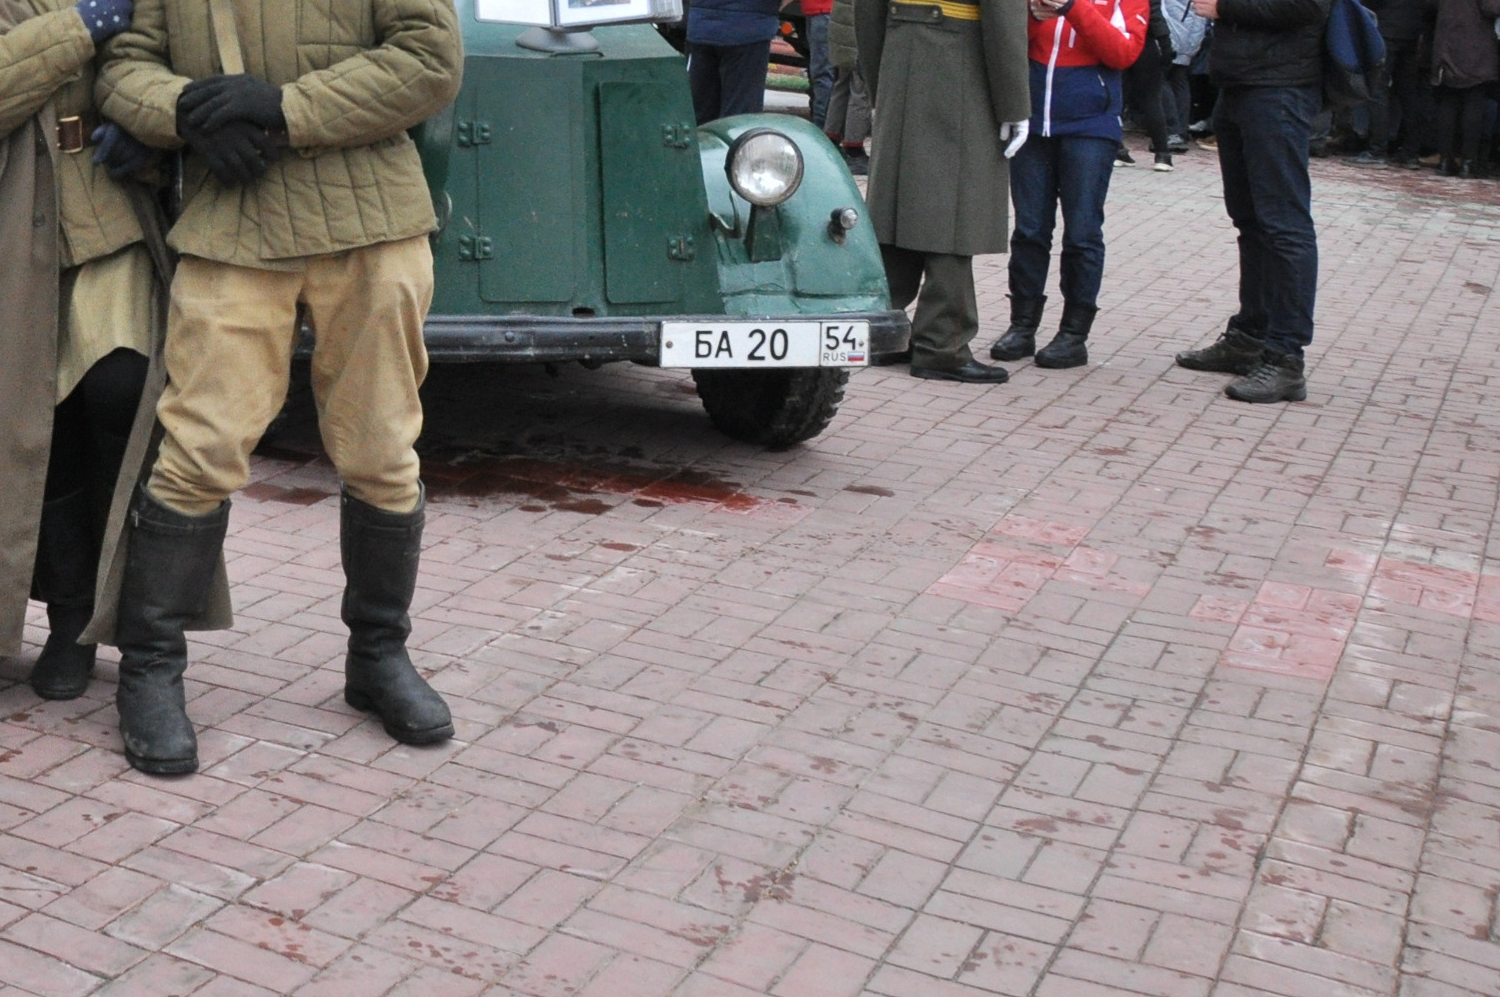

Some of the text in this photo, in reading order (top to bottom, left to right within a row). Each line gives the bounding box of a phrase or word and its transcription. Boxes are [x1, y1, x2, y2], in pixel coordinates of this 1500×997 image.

[694, 329, 789, 361] БА 20
[824, 325, 857, 351] 54
[823, 352, 847, 362] RUS
